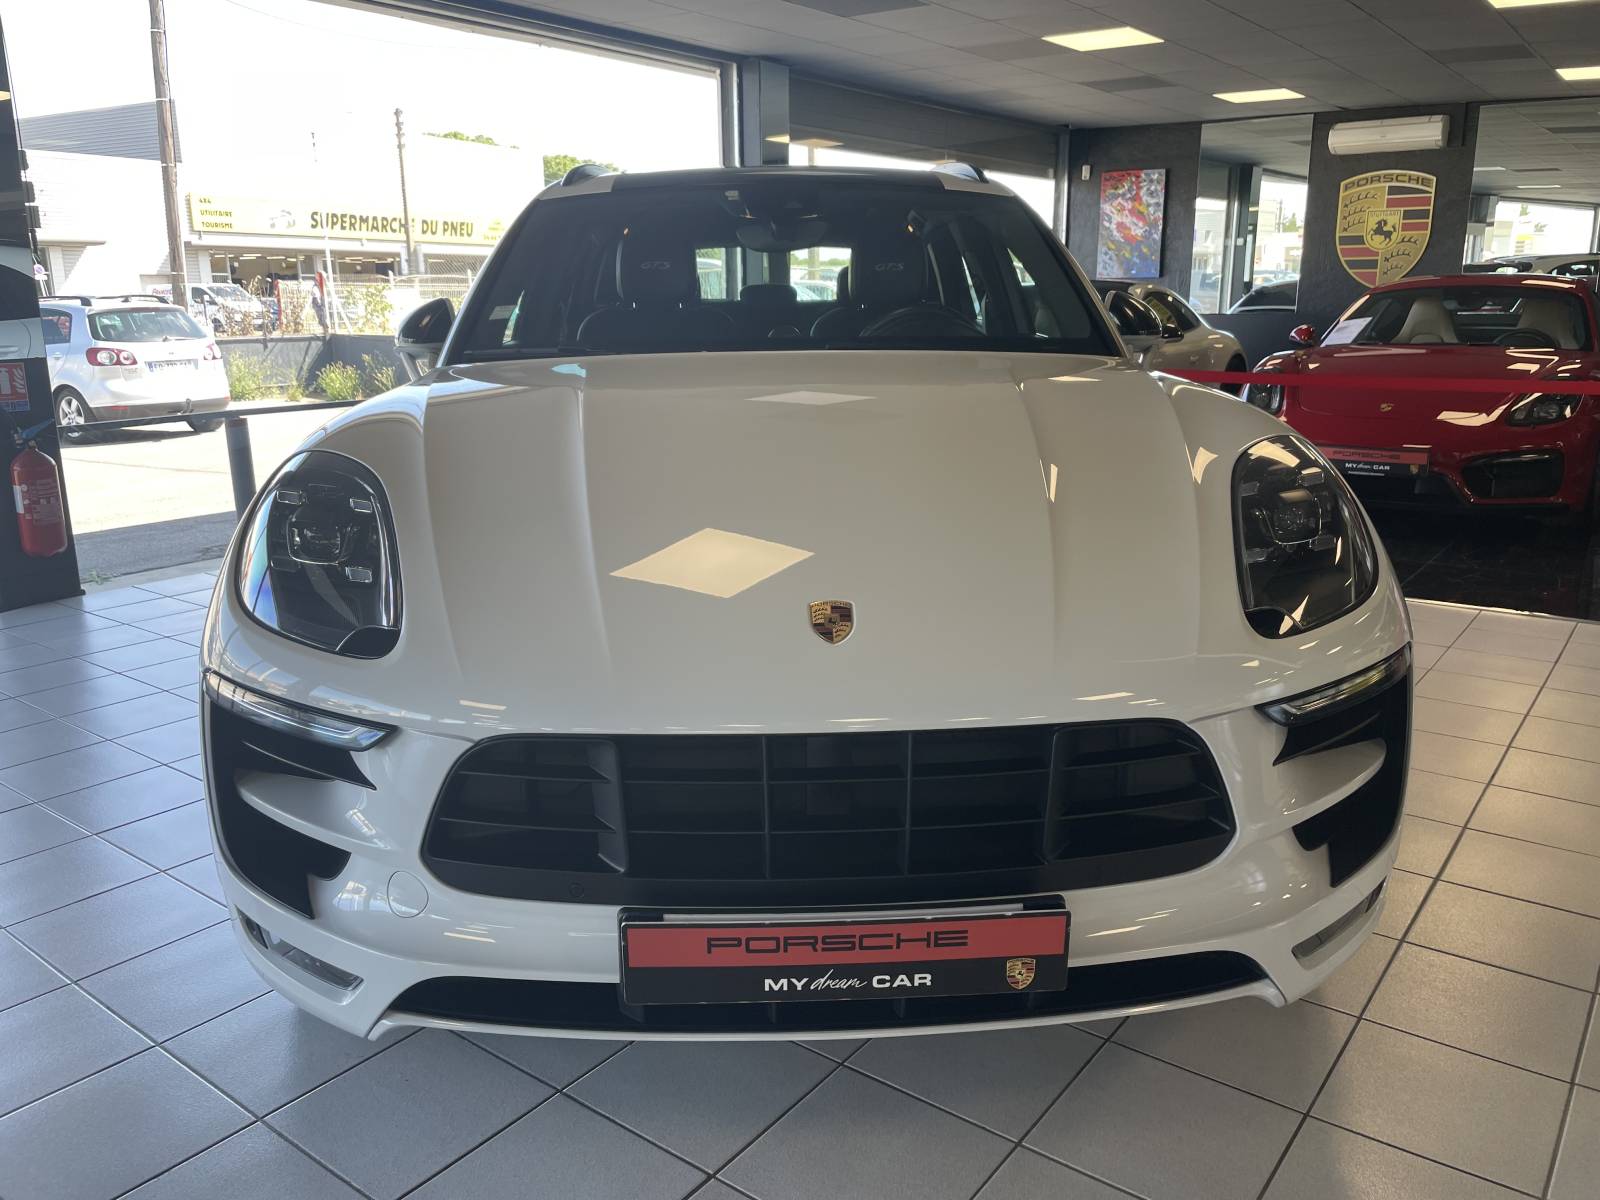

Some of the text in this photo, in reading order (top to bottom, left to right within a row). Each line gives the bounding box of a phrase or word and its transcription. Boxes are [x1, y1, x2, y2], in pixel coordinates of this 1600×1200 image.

[1345, 175, 1432, 191] PORSCHE
[200, 209, 233, 217] UTILITAIRE
[201, 221, 233, 229] TOURISME
[421, 219, 438, 235] DU
[442, 220, 474, 237] PNEU
[640, 261, 671, 270] GTS
[875, 262, 905, 271] GTS
[706, 929, 969, 955] PORSCHE
[764, 968, 933, 992] MY dream CAR
